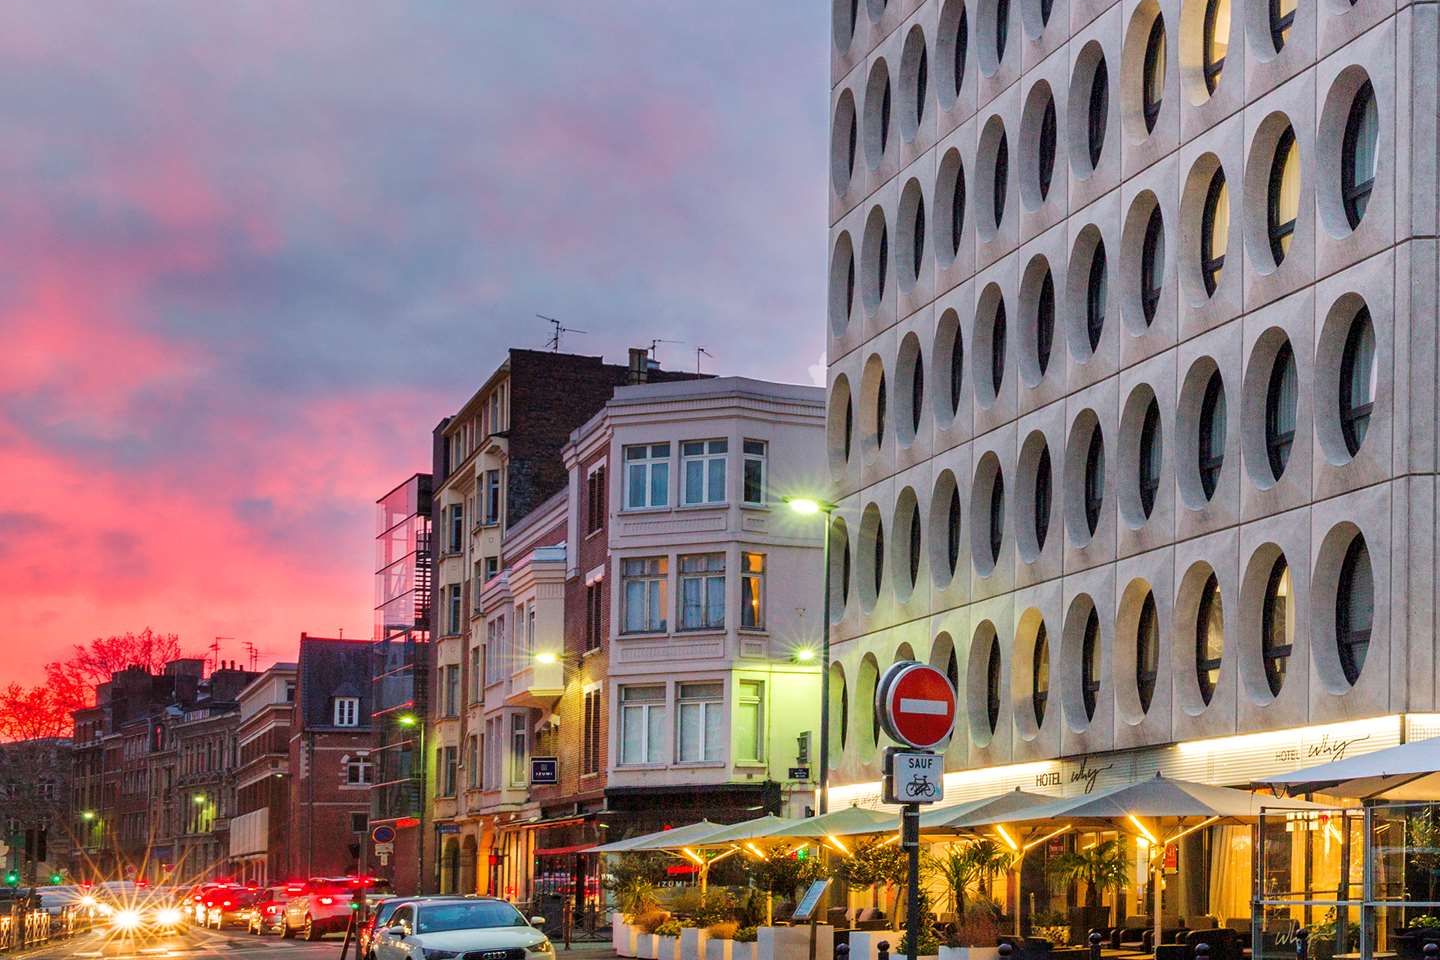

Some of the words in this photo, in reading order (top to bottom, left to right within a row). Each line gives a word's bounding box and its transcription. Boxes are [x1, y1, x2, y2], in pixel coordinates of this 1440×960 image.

[1275, 750, 1300, 761] HOTEL
[908, 758, 933, 769] SAUF
[1036, 772, 1062, 786] HOTEL
